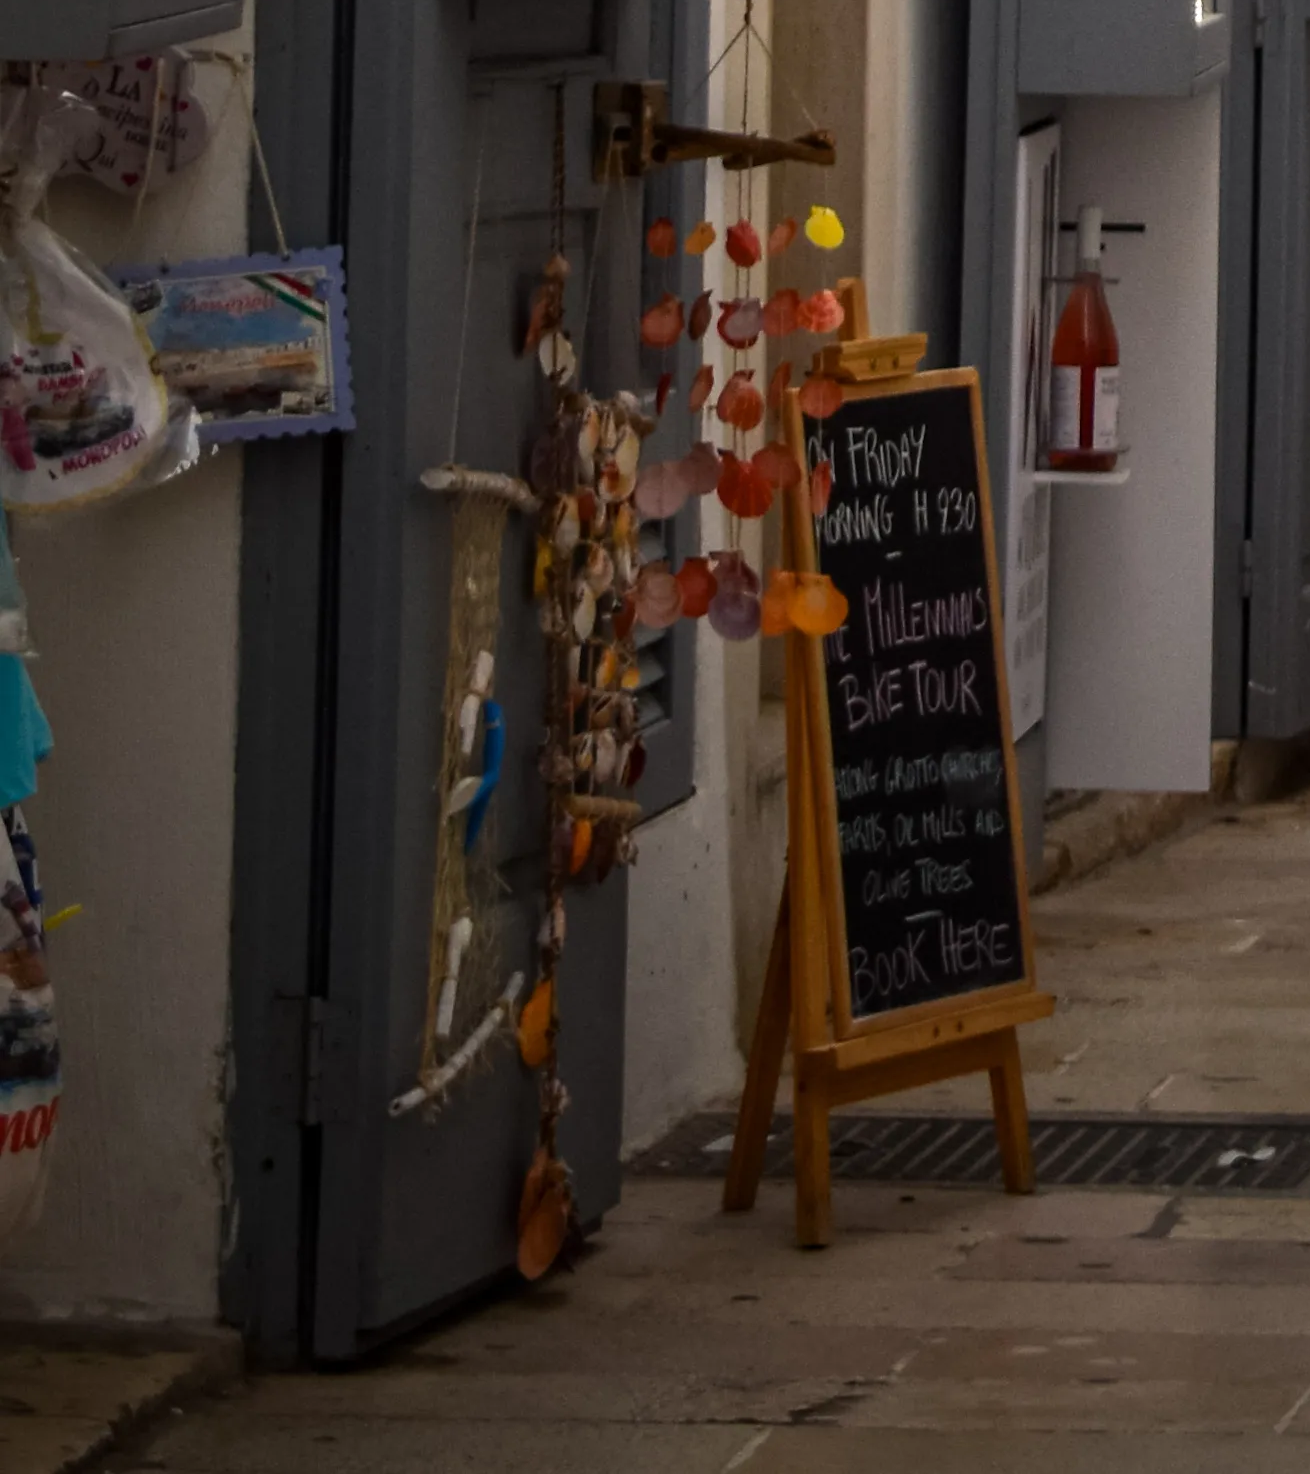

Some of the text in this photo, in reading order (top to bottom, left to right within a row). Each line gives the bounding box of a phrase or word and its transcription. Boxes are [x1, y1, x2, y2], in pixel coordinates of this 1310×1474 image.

[845, 423, 927, 489] FRIDAY
[913, 487, 930, 536] H
[838, 659, 984, 732] BIKE TOUR
[921, 802, 968, 845] MILLS
[914, 855, 976, 896] TREES
[850, 916, 1014, 1011] BOOK HERE
